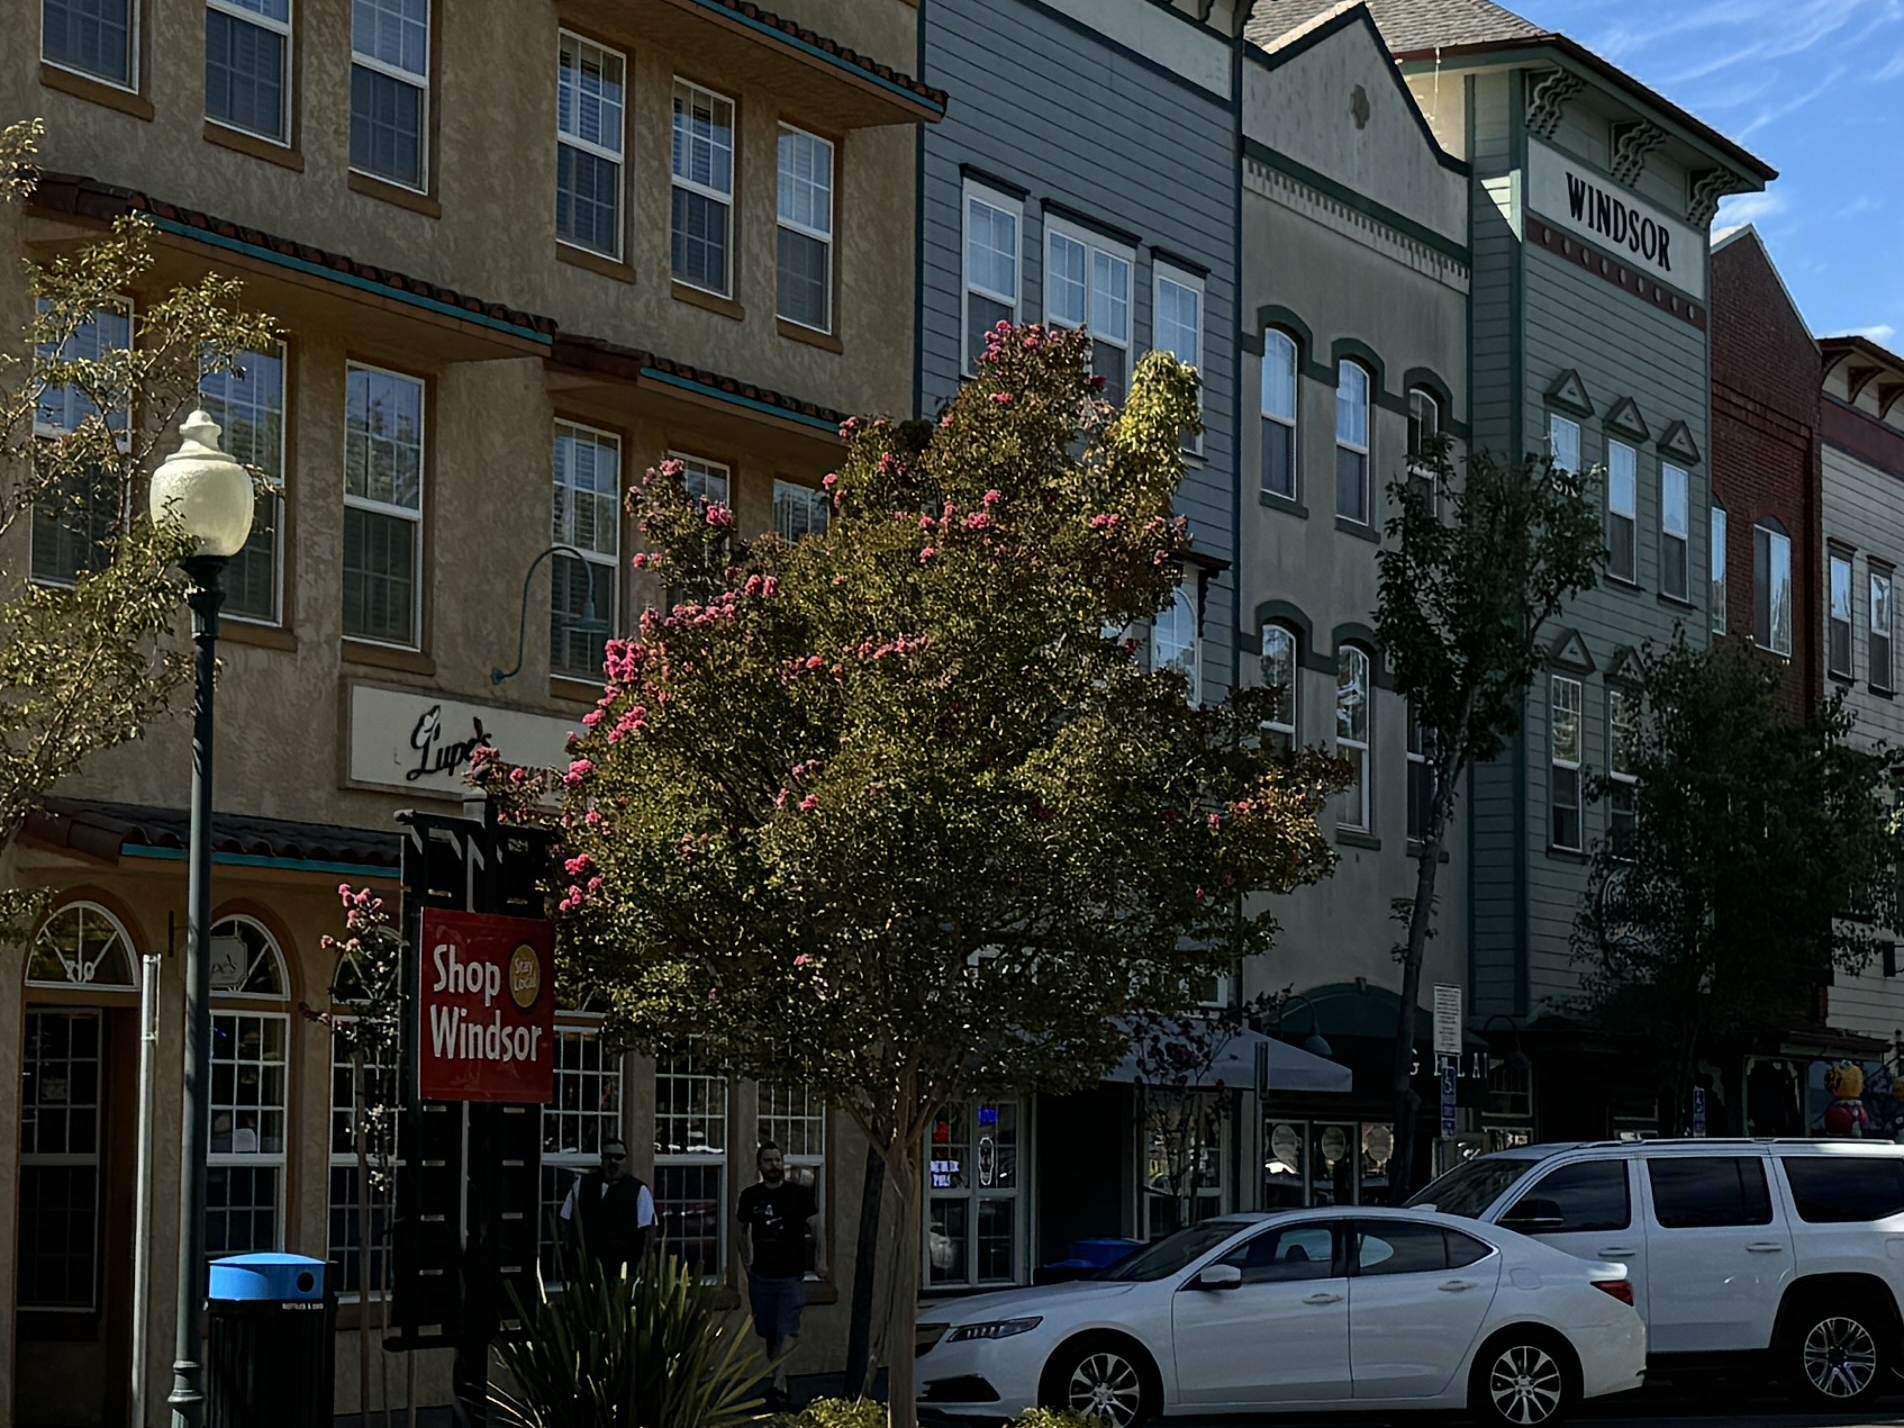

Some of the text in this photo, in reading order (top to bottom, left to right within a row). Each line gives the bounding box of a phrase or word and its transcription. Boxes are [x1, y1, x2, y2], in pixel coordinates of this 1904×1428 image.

[1565, 172, 1671, 272] WINDSOR
[433, 944, 501, 1007] Shop
[514, 971, 537, 991] Local
[515, 957, 534, 977] Stay
[430, 1004, 542, 1062] Windsor
